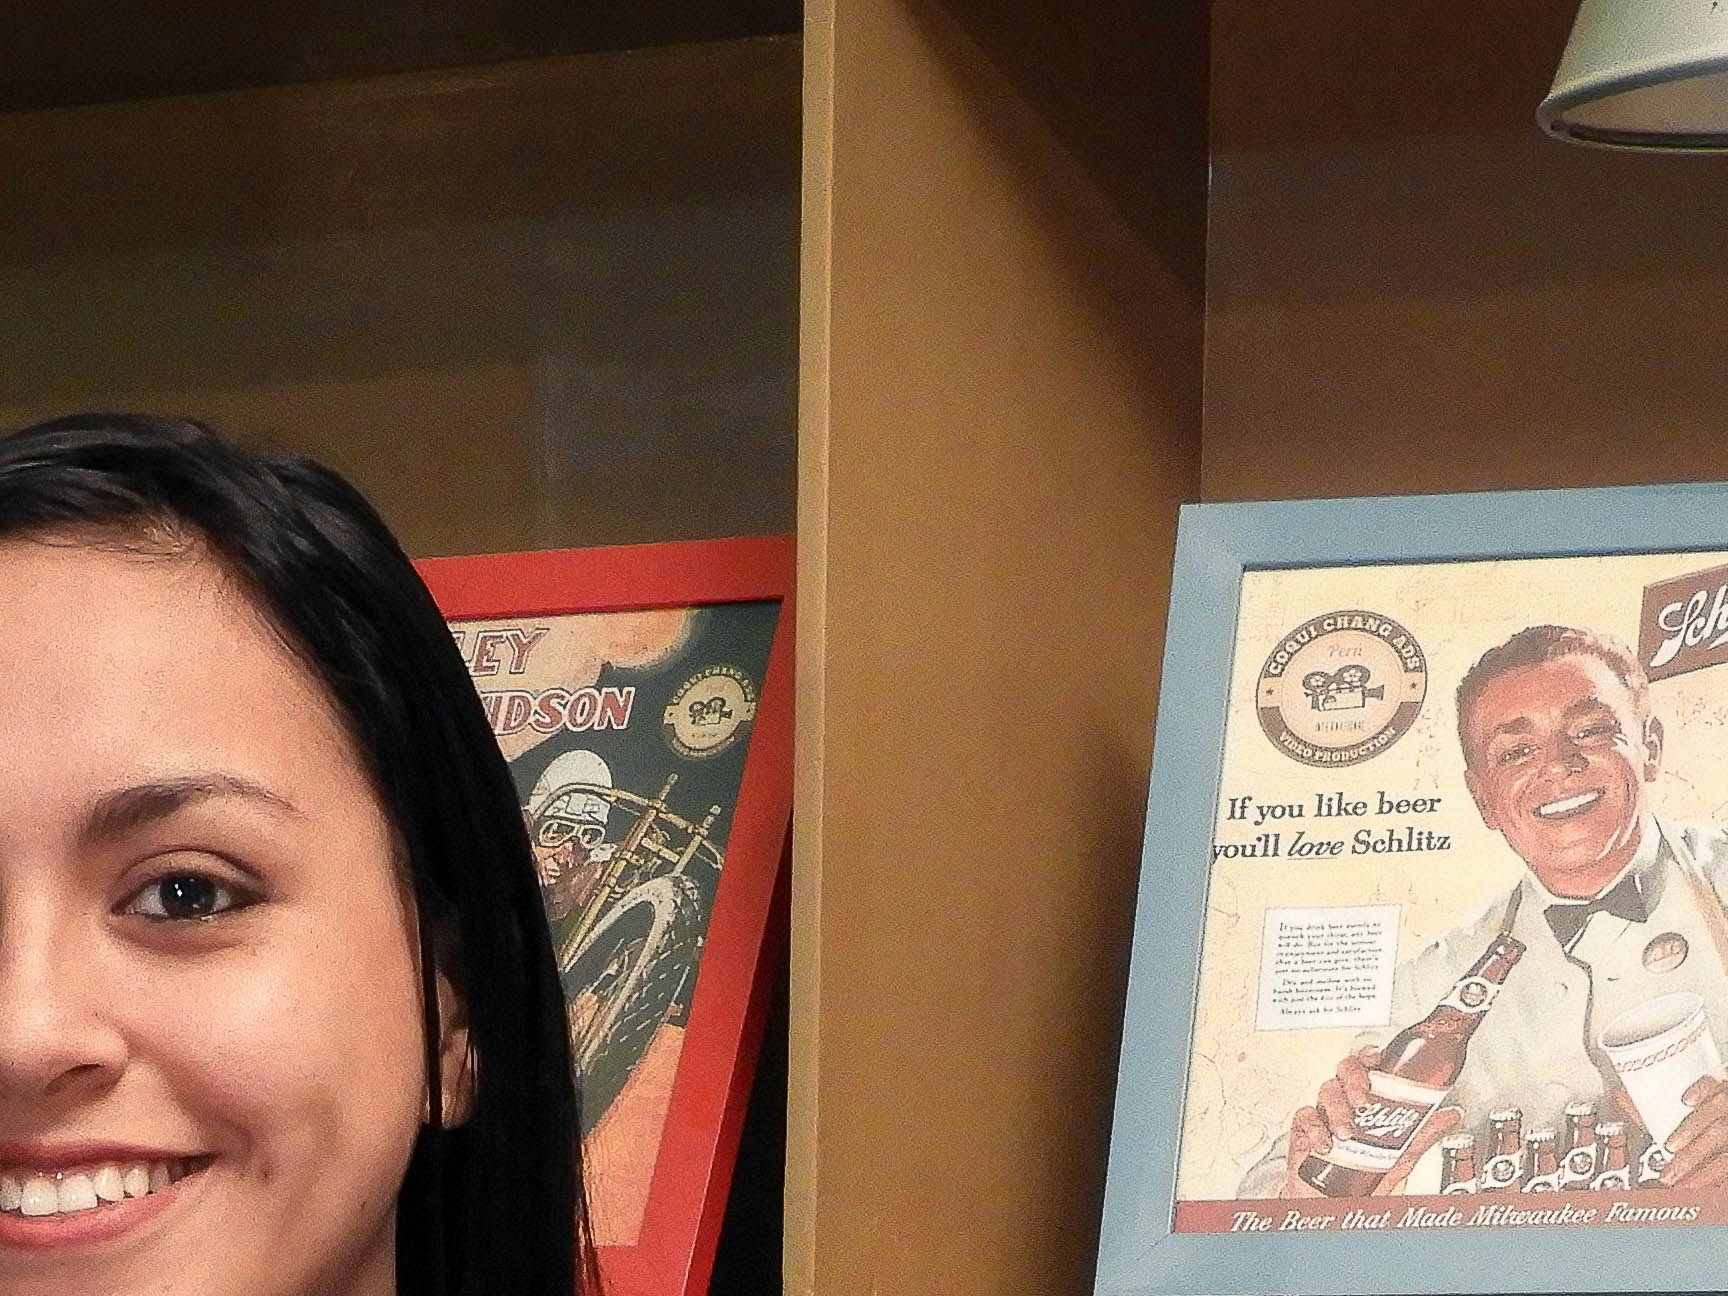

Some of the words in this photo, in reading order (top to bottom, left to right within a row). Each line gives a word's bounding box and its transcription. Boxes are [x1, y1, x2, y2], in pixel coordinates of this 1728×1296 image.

[1268, 626, 1317, 675] COQUI
[1323, 615, 1392, 637] CHANG
[1392, 635, 1421, 670] ADS
[1278, 731, 1312, 757] VIDEO
[1314, 728, 1396, 762] PRODUCTION
[1227, 796, 1253, 821] If
[1253, 803, 1305, 826] you
[1313, 792, 1368, 817] like
[1375, 791, 1442, 816] beer
[1212, 832, 1280, 865] you'll
[1287, 831, 1344, 858] love
[1351, 827, 1452, 855] Schlitz
[1230, 1211, 1272, 1232] The
[1279, 1211, 1336, 1231] Beer
[1342, 1209, 1390, 1229] that
[1397, 1207, 1462, 1228] Made
[1468, 1203, 1596, 1226] Milwaukee
[1605, 1202, 1700, 1223] Famous
